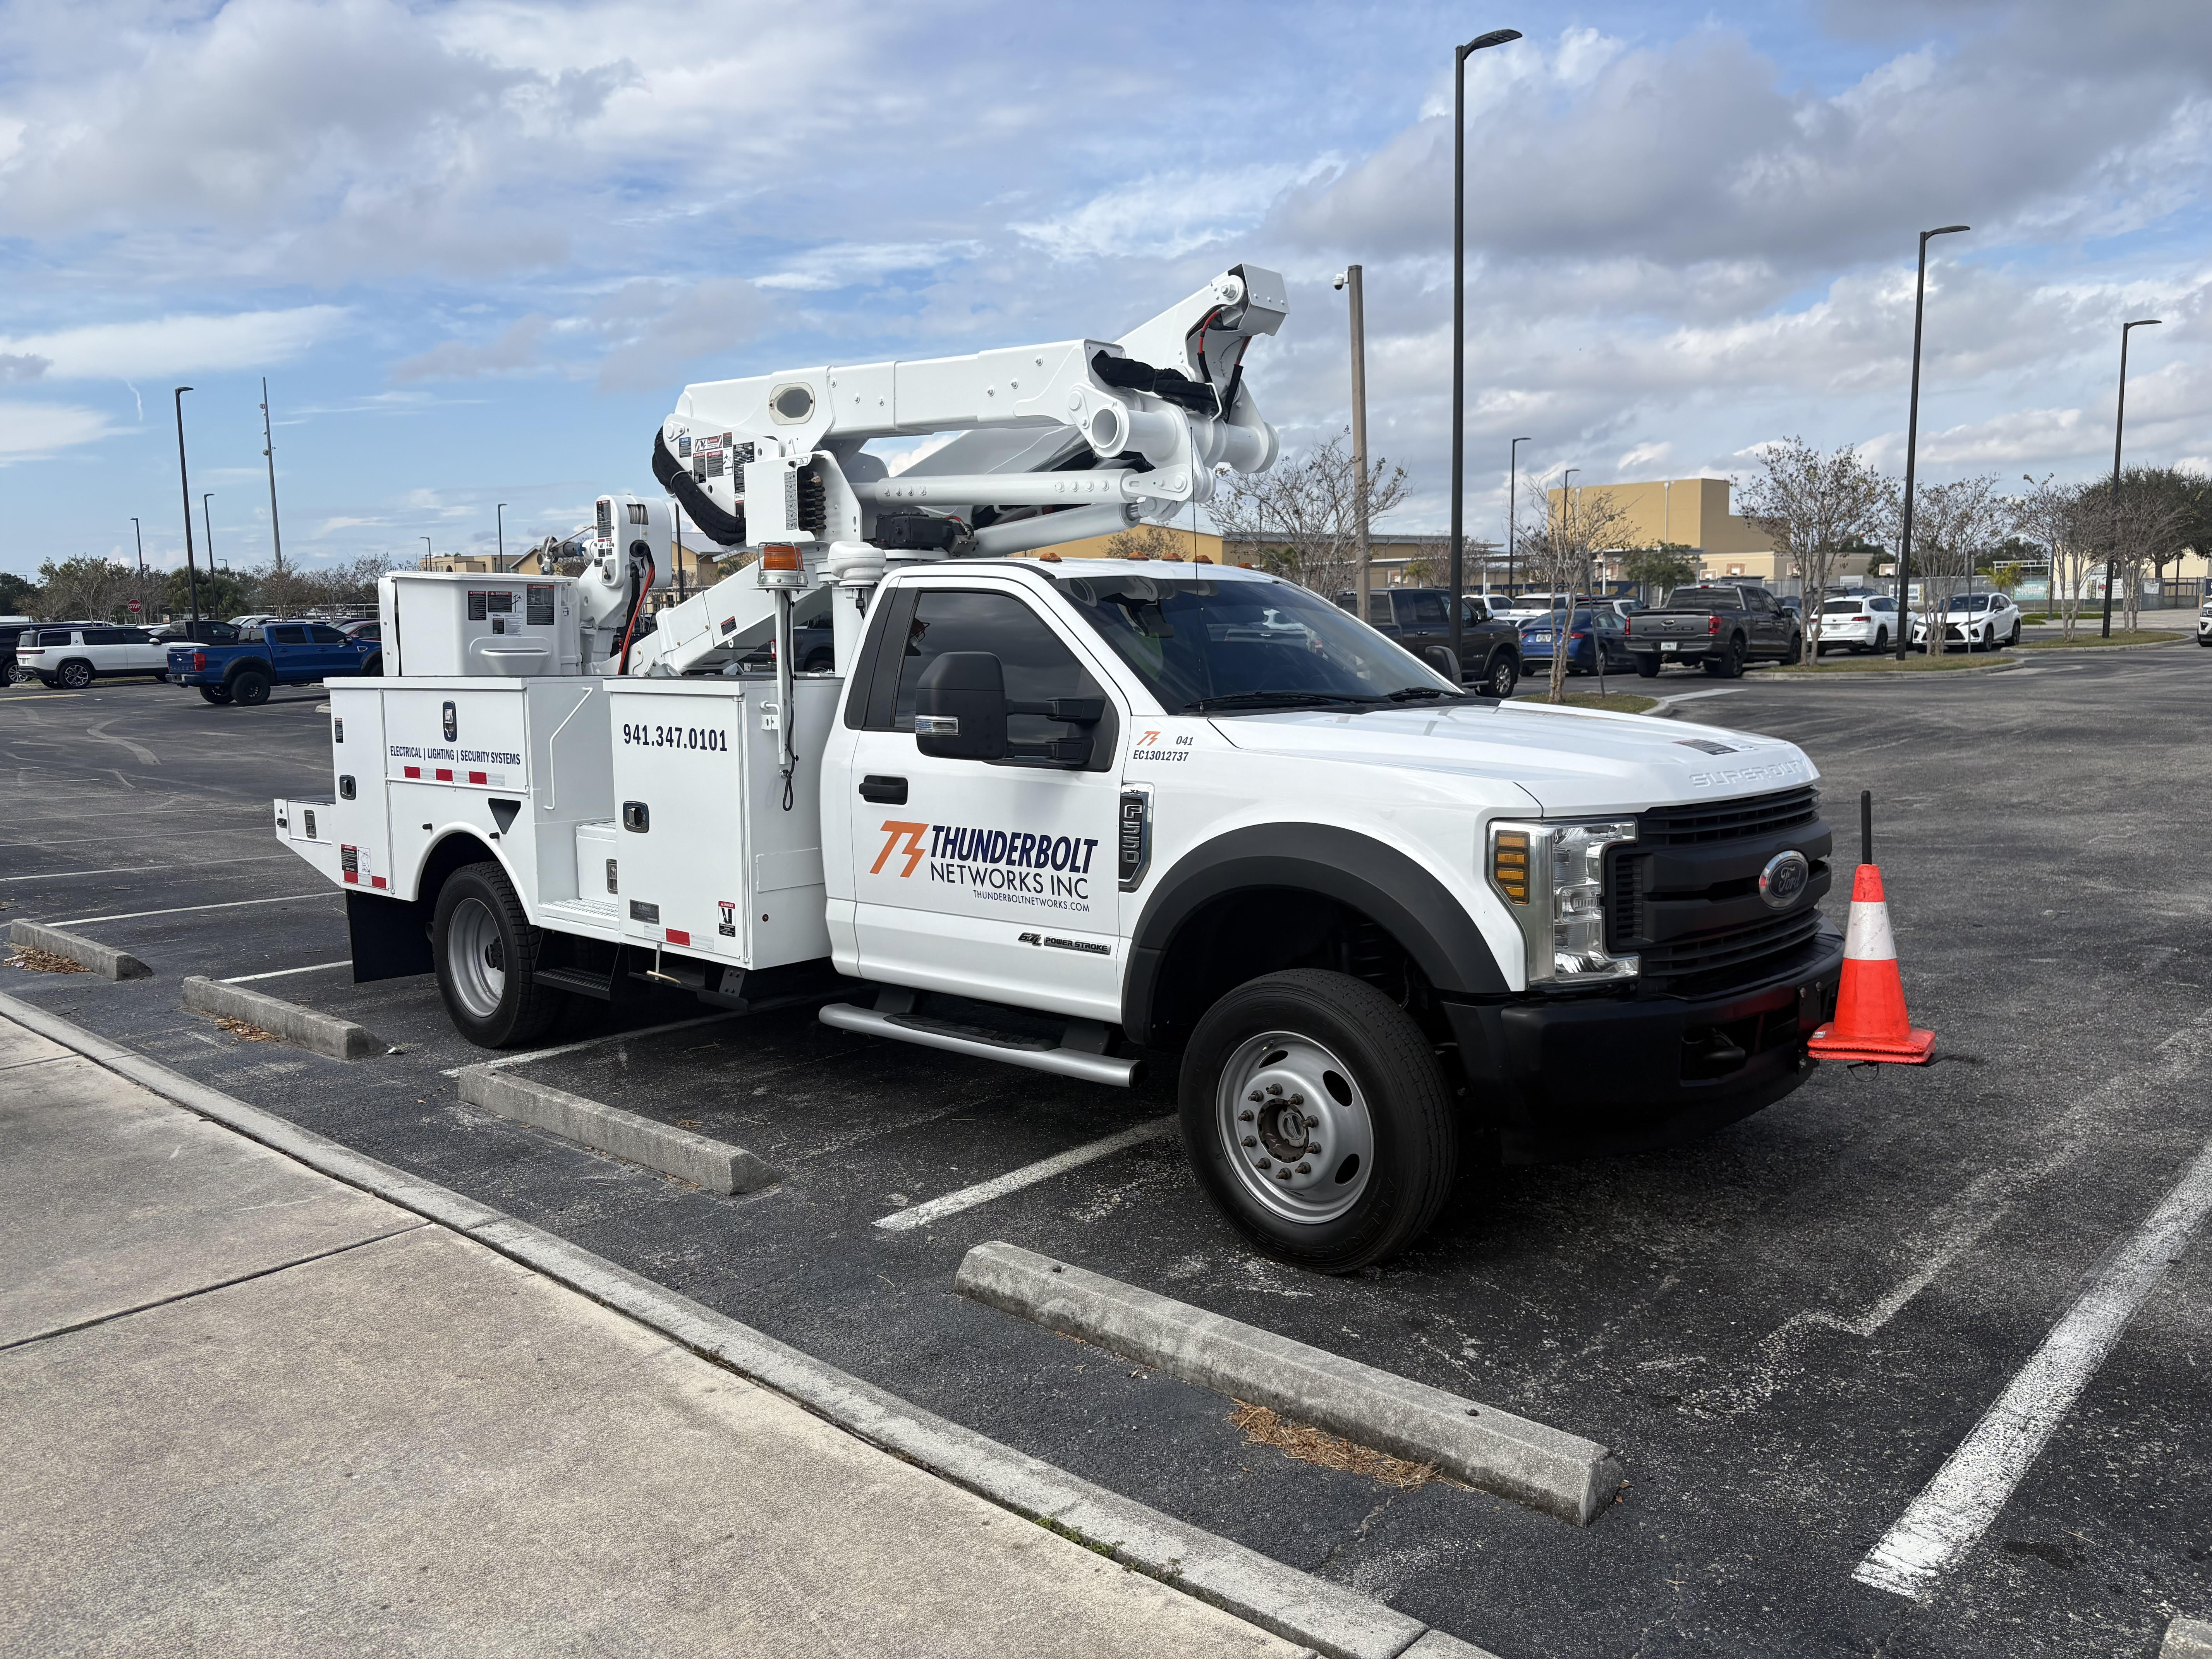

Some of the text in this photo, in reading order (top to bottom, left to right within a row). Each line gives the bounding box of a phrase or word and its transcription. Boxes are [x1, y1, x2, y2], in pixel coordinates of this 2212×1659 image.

[623, 723, 727, 752] 941.347.0101
[1176, 736, 1193, 745] 041
[390, 745, 422, 758] ELECTRICAL
[428, 748, 454, 760] LIGHTING
[460, 750, 489, 763] SECURITY
[491, 752, 520, 765] SYSTEMS
[1133, 750, 1189, 761] EC13012737
[1689, 766, 1771, 788] SUPER
[931, 825, 1098, 874] THUNDERBOLT
[931, 861, 1089, 900] NETWORKS INC
[1778, 866, 1801, 892] Ford
[973, 890, 1090, 913] THUNDERBOLTNETWORKS.COM
[1045, 937, 1073, 946] POWER
[1075, 941, 1108, 951] STROKE
